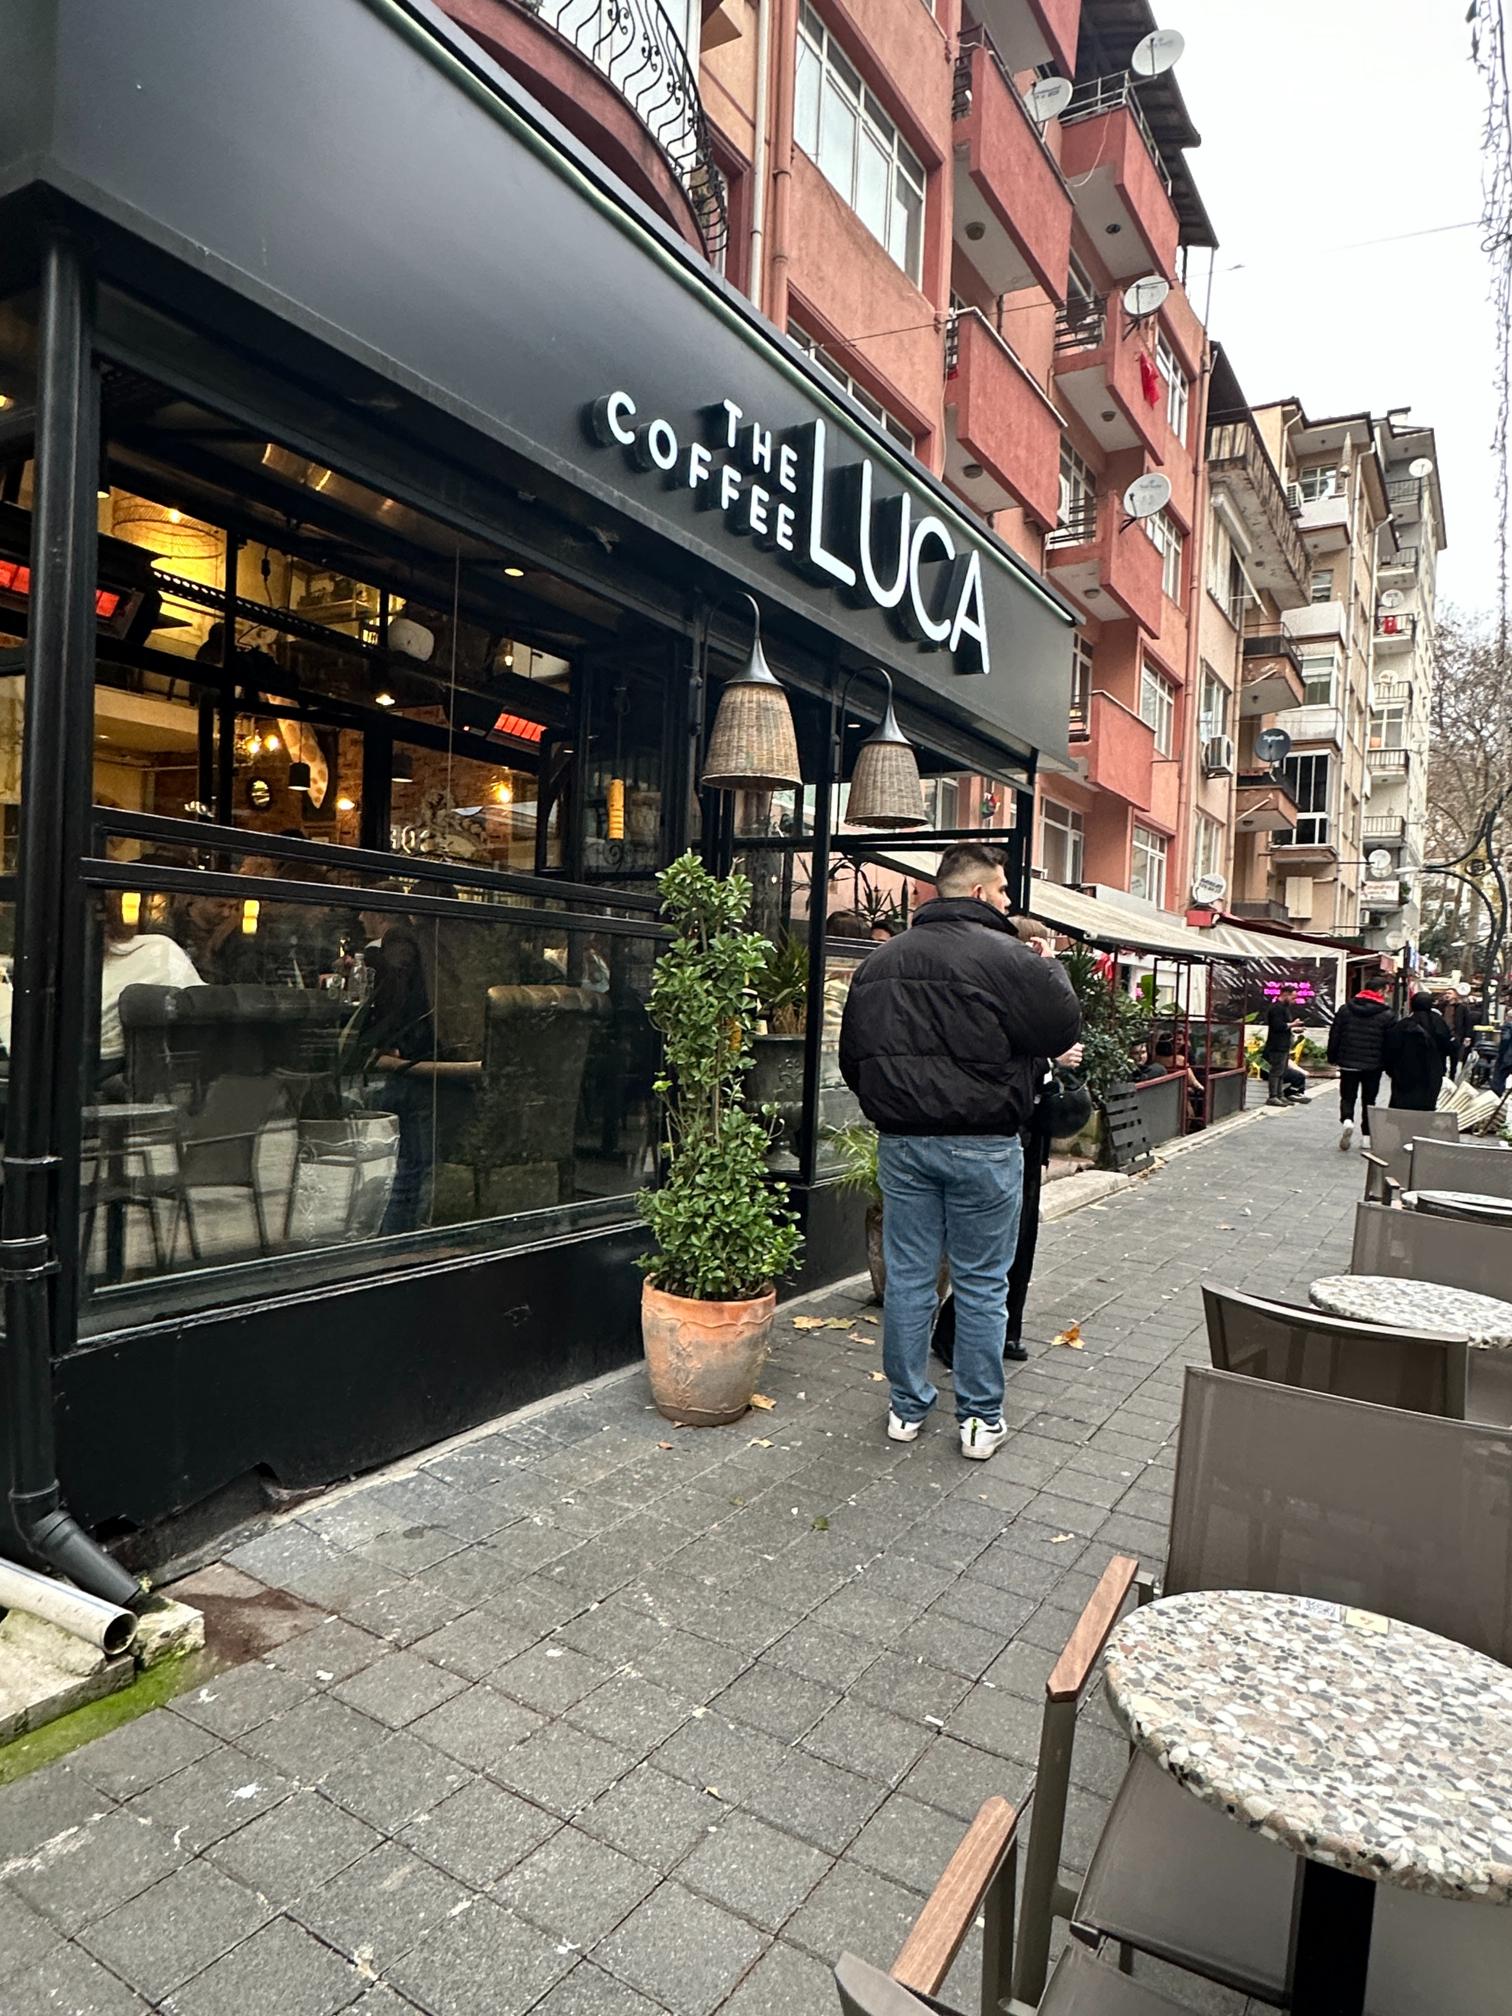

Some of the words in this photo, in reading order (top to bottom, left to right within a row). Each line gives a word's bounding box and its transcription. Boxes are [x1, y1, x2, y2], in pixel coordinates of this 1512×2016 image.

[606, 390, 796, 552] COFFEE
[723, 399, 799, 494] THE
[809, 417, 991, 675] LUCA
